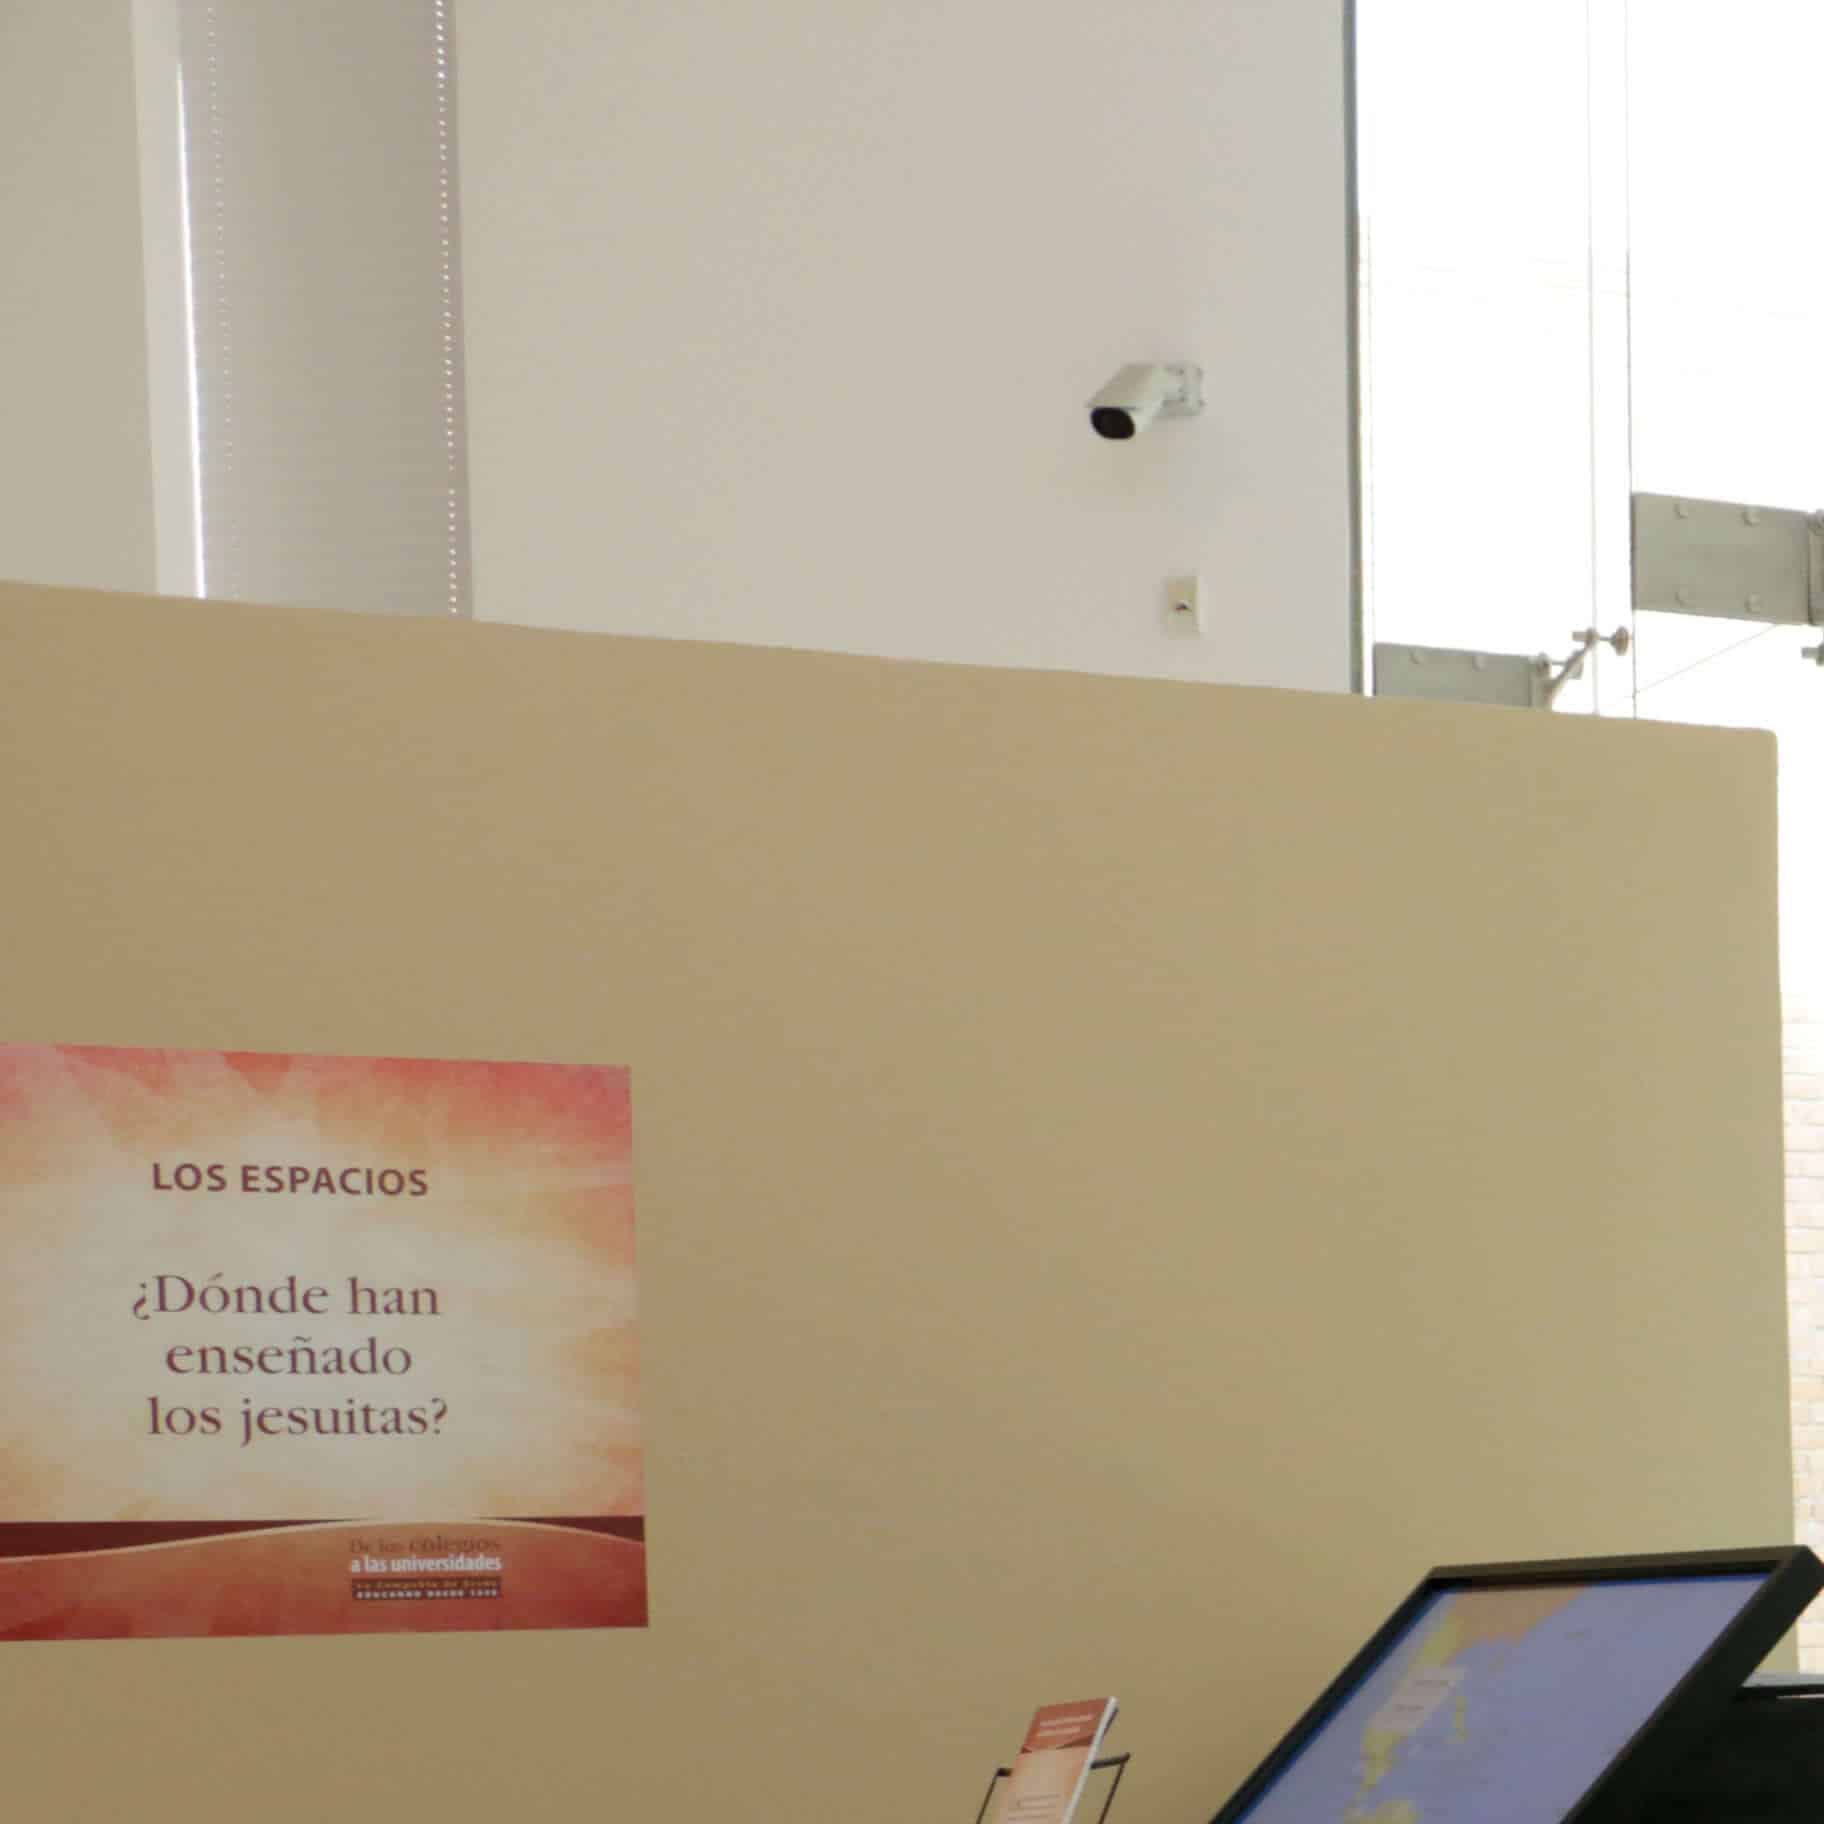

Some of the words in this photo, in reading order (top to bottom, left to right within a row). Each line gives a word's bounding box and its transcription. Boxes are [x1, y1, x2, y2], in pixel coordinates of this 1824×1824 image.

[152, 1162, 228, 1192] LOS
[240, 1165, 428, 1196] ESPACIOS
[132, 1272, 329, 1320] ¿Dónde
[348, 1275, 444, 1316] han
[165, 1336, 412, 1375] enseñado
[146, 1395, 222, 1435] los
[241, 1397, 448, 1448] jesuitas?
[350, 1558, 360, 1572] a
[364, 1553, 387, 1572] las
[391, 1553, 502, 1572] universidades
